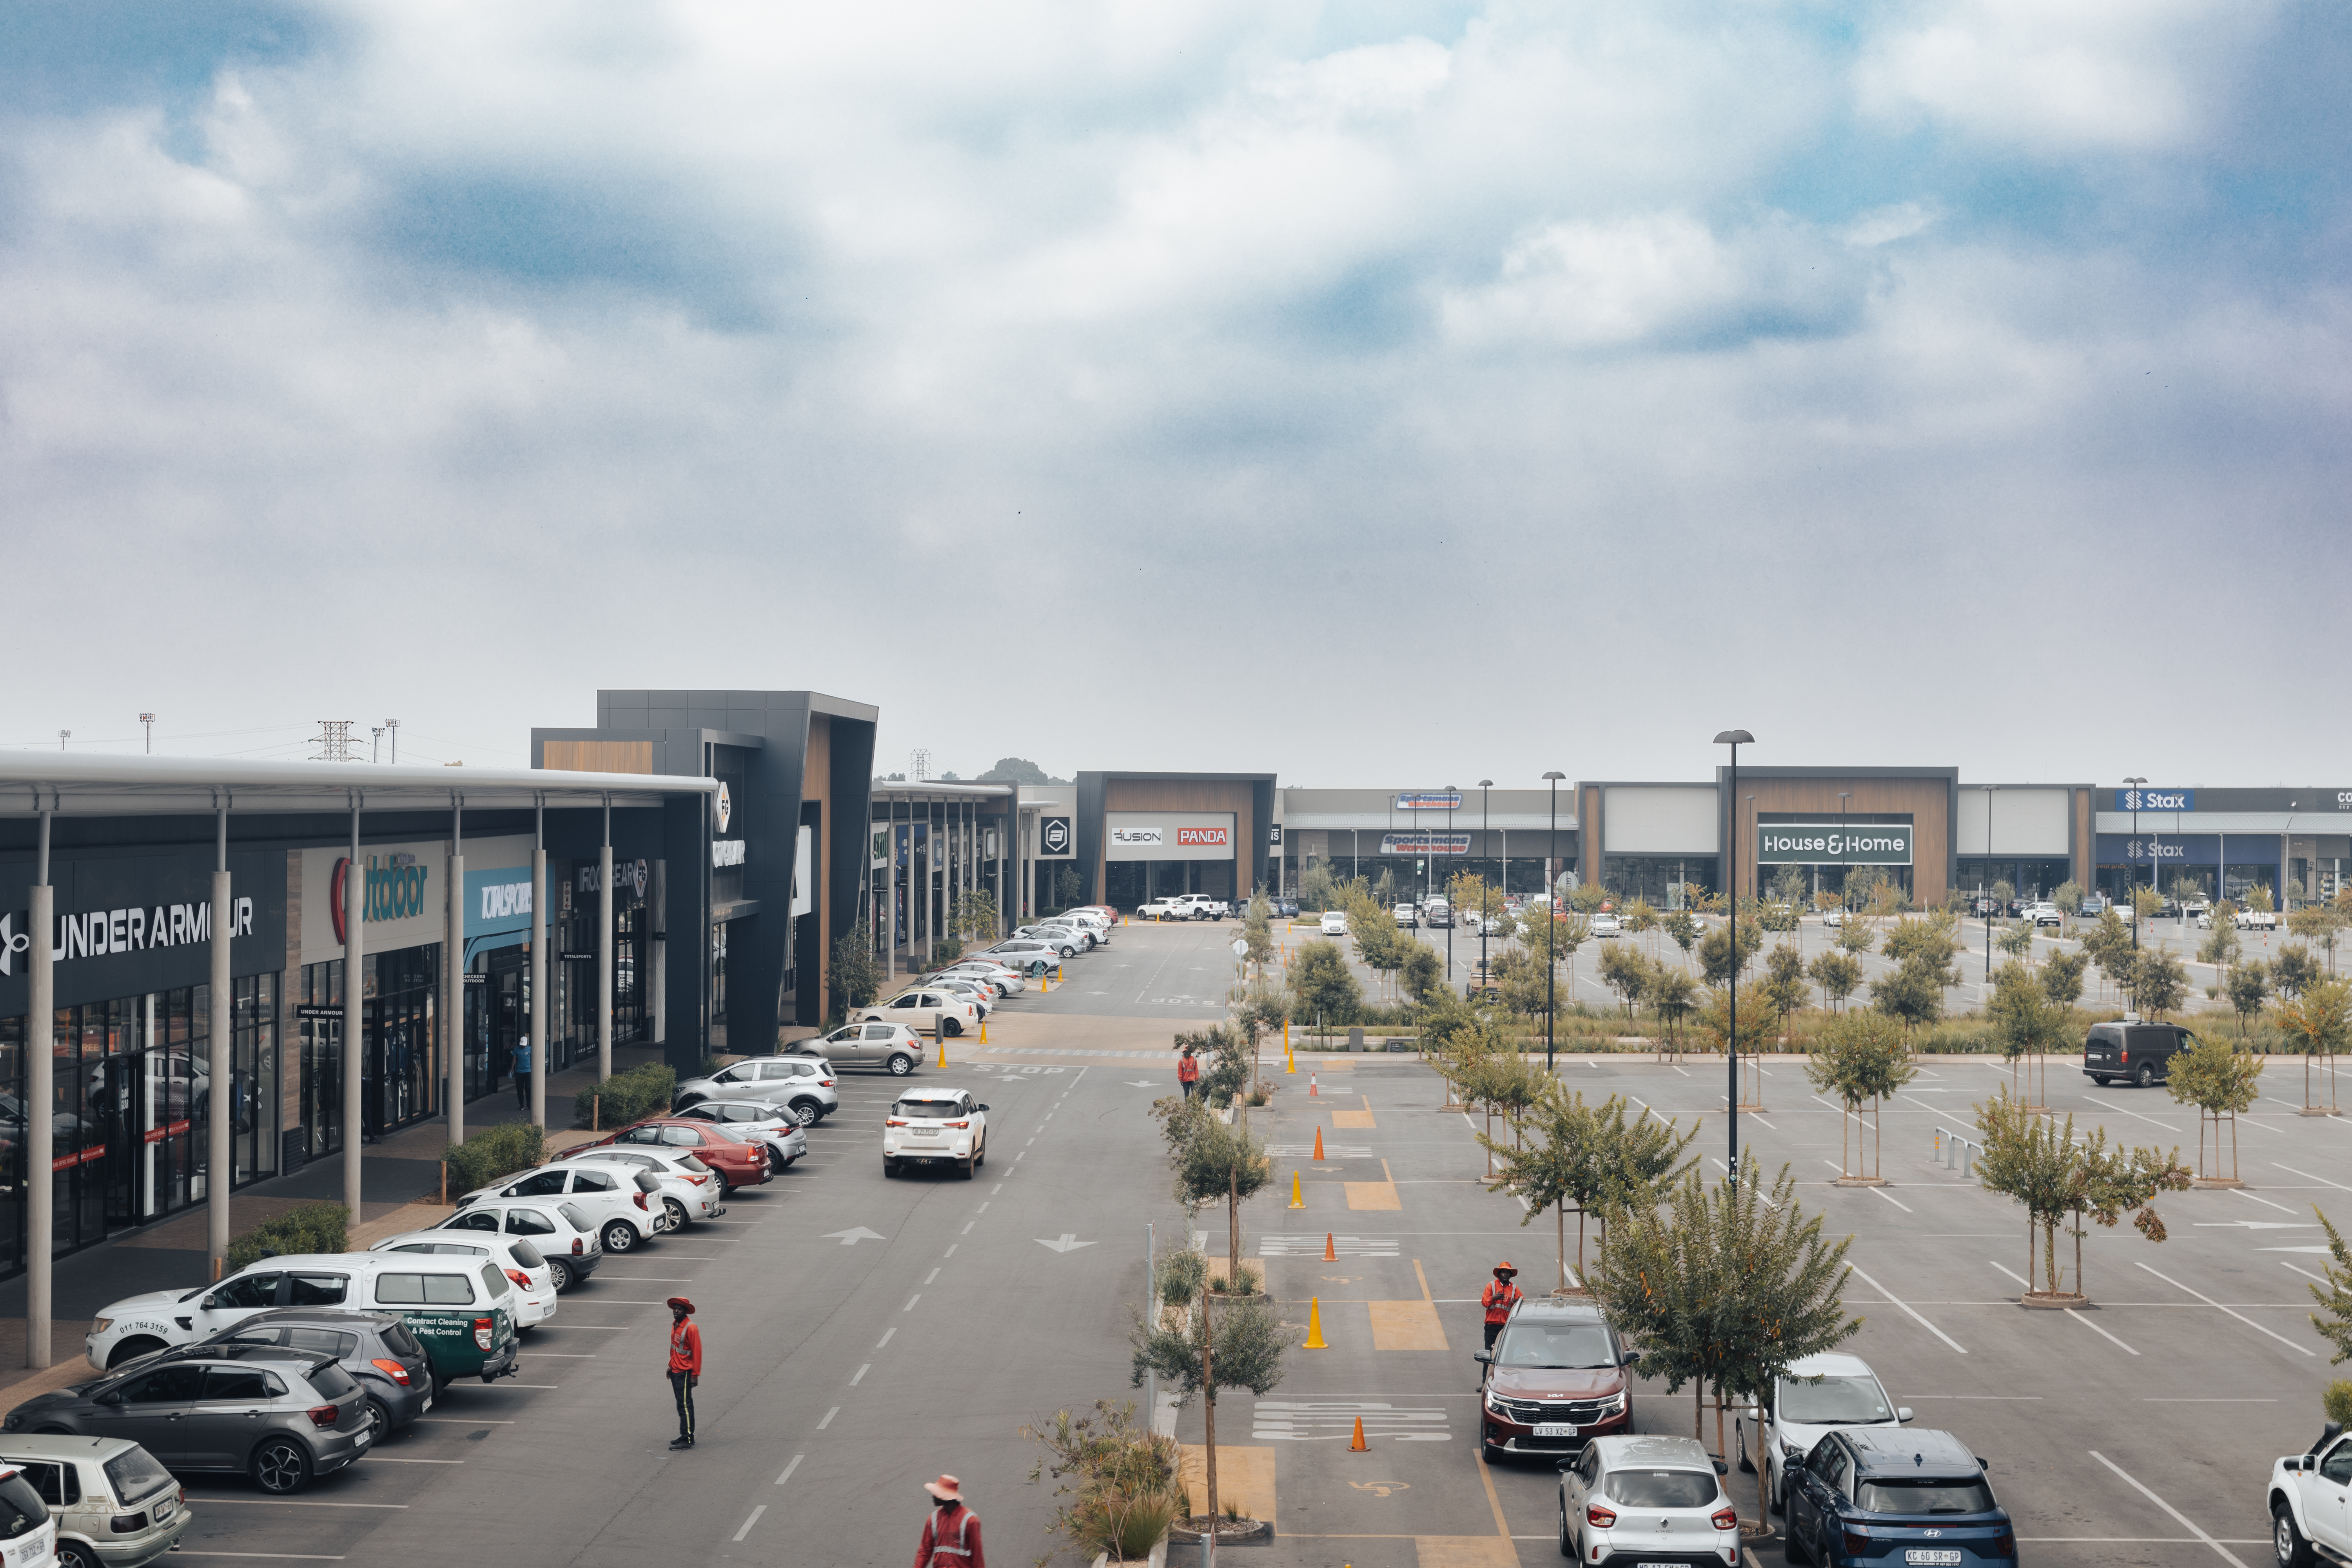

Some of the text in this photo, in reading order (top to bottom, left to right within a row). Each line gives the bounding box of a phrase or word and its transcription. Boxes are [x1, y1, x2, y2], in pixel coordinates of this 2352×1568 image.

[2147, 793, 2185, 808] Stax
[1180, 830, 1226, 842] PANDA
[1384, 836, 1468, 845] Sportsmans
[1764, 835, 1825, 852] House
[1846, 836, 1905, 852] Home
[2148, 843, 2184, 857] Stax
[53, 897, 252, 961] UNDER ARMUR
[82, 1044, 99, 1052] REE
[973, 1064, 1065, 1074] STOP
[407, 1318, 468, 1328] Contract Cleaning
[120, 1323, 132, 1334] 011
[151, 1323, 168, 1334] 3159
[39, 1541, 44, 1551] GP
[1908, 1552, 1959, 1561] KC 60 SR GP
